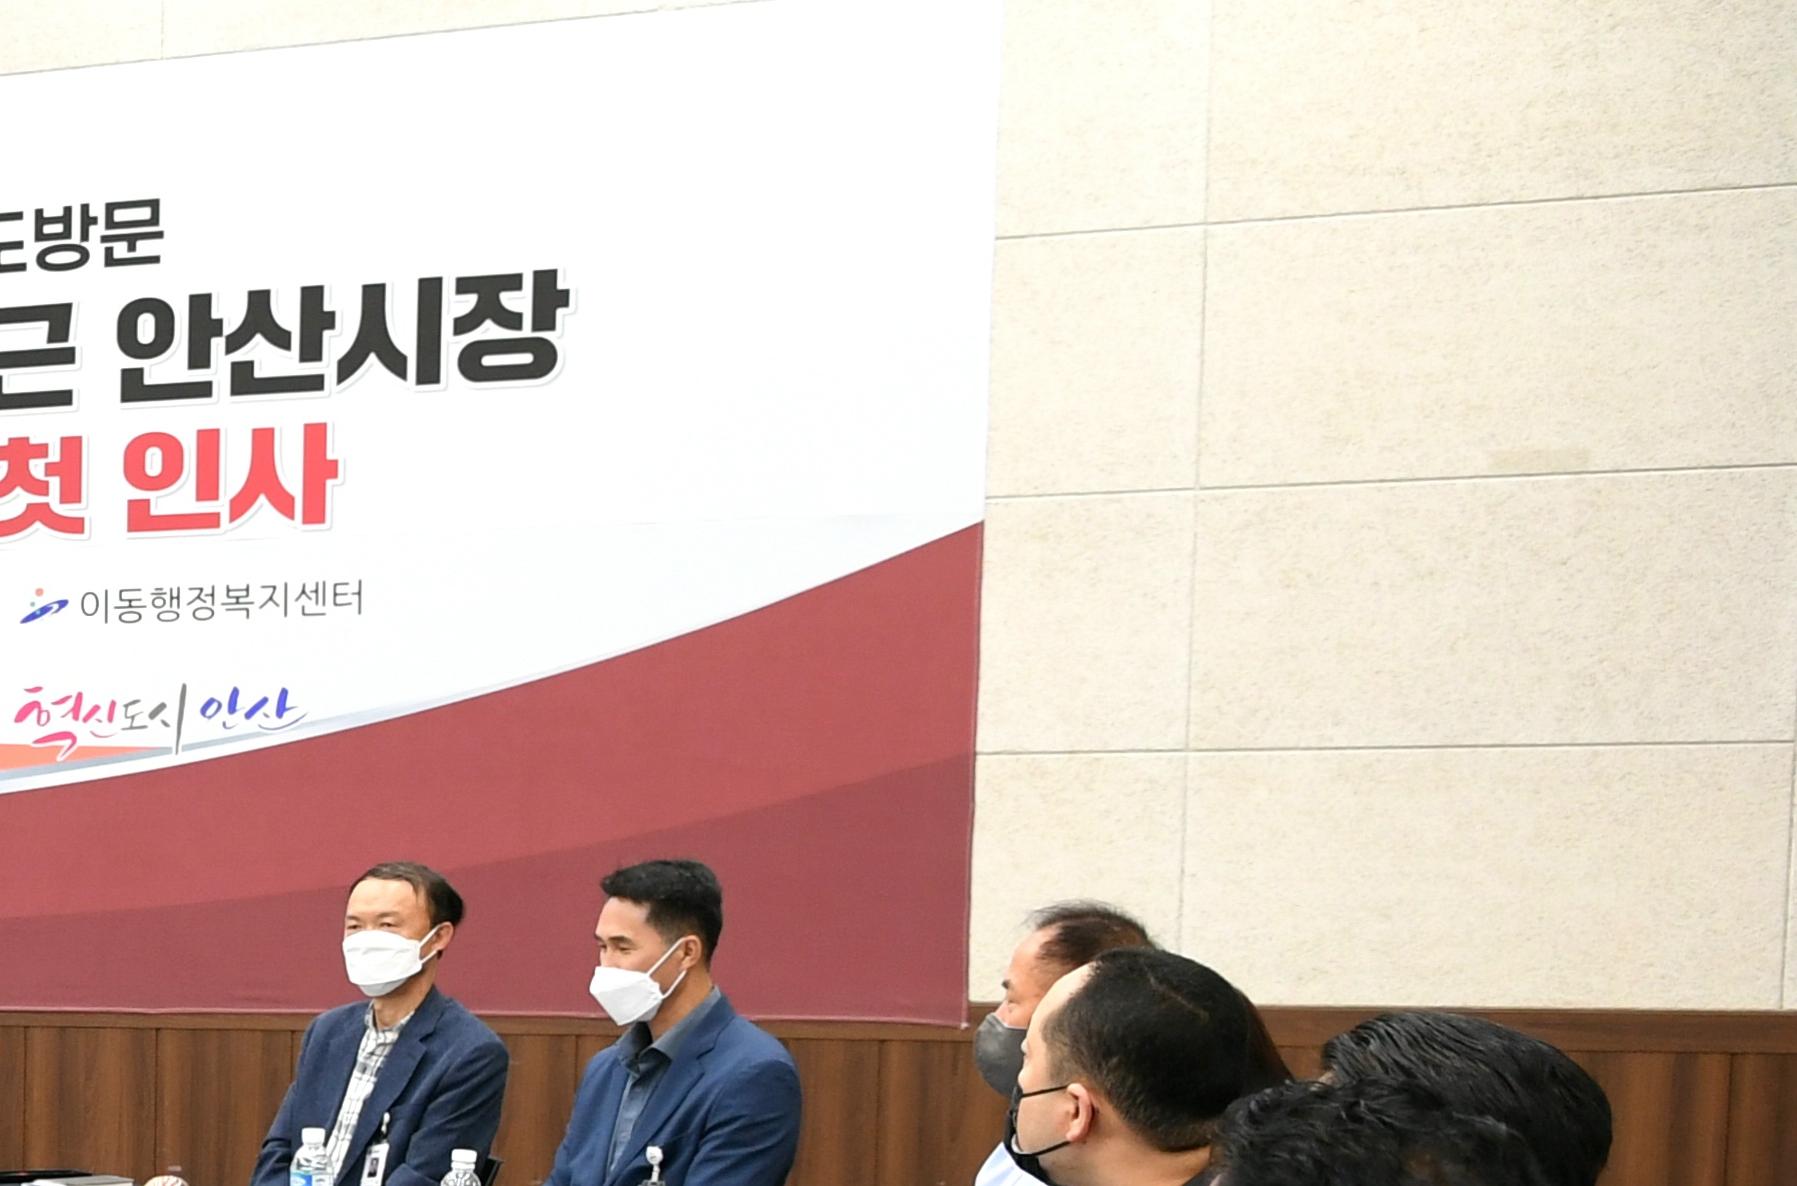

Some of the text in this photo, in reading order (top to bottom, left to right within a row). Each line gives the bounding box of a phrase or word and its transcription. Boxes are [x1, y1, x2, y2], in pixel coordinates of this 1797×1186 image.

[116, 268, 570, 404] 안산시장
[123, 421, 339, 533] 인사
[80, 578, 364, 624] 이동행정복지센터
[13, 682, 188, 760] 혁신도시
[199, 685, 308, 732] 안산
